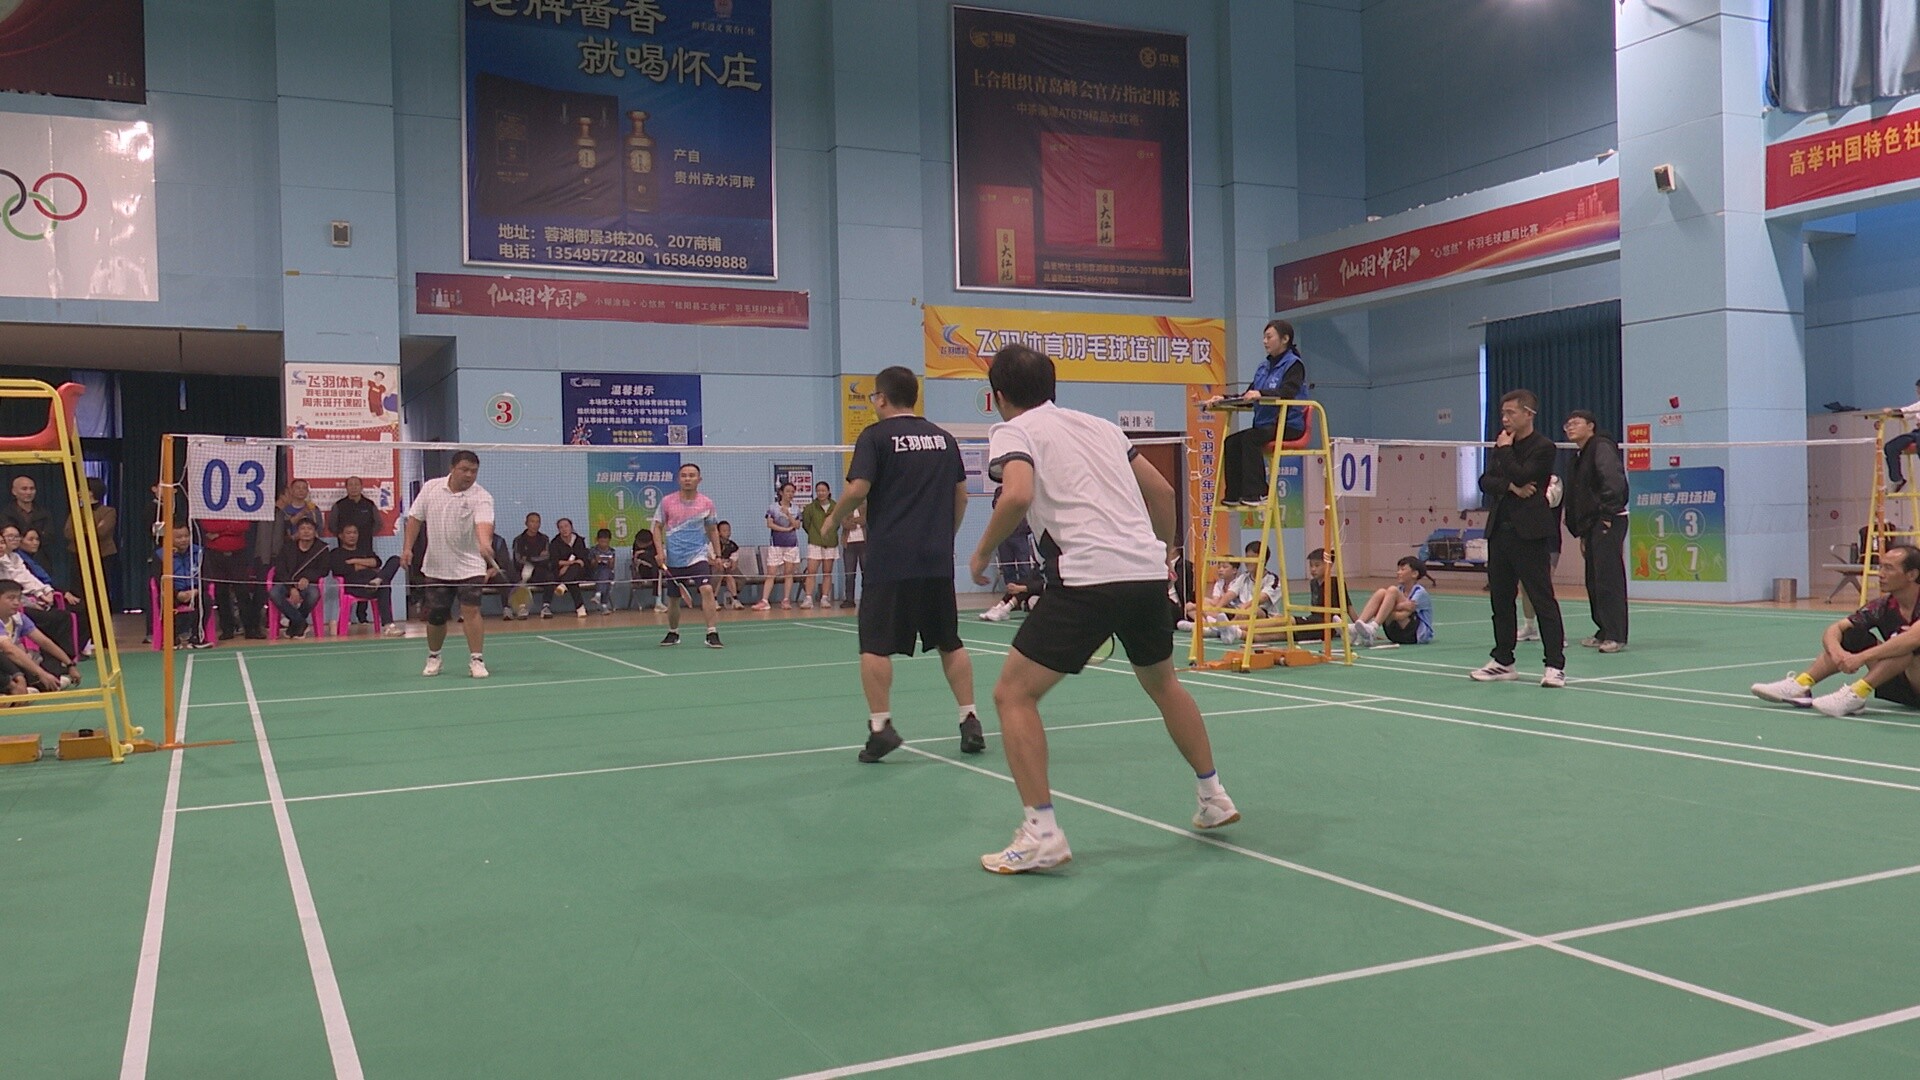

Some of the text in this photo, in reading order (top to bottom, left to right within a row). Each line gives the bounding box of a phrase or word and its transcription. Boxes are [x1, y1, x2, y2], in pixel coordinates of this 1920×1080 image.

[577, 36, 763, 92] 就喝怀庄
[971, 69, 1181, 108] 上合组织青岛峰会官方指定用茶
[674, 149, 700, 163] 产自
[1789, 120, 1920, 177] 高举中国特色社
[674, 170, 755, 190] 贵州赤水河畔
[653, 252, 748, 270] 16584699888
[976, 329, 1212, 365] 飞羽体育羽毛球培训学校
[308, 375, 363, 389] 飞羽体育
[611, 384, 655, 396] 温馨提示
[305, 388, 362, 398] 羽毛球培训学校
[496, 401, 512, 424] 3
[891, 435, 947, 453] 飞羽体育
[595, 471, 674, 483] 培训专用场地
[1340, 452, 1372, 491] 01
[202, 458, 265, 513] 03
[1278, 481, 1287, 498] 3
[616, 488, 656, 511] 1 3
[1636, 491, 1717, 506] 培训专用场地
[615, 518, 627, 538] 5
[1655, 511, 1698, 537] 1 3
[1655, 547, 1699, 571] 5 7
